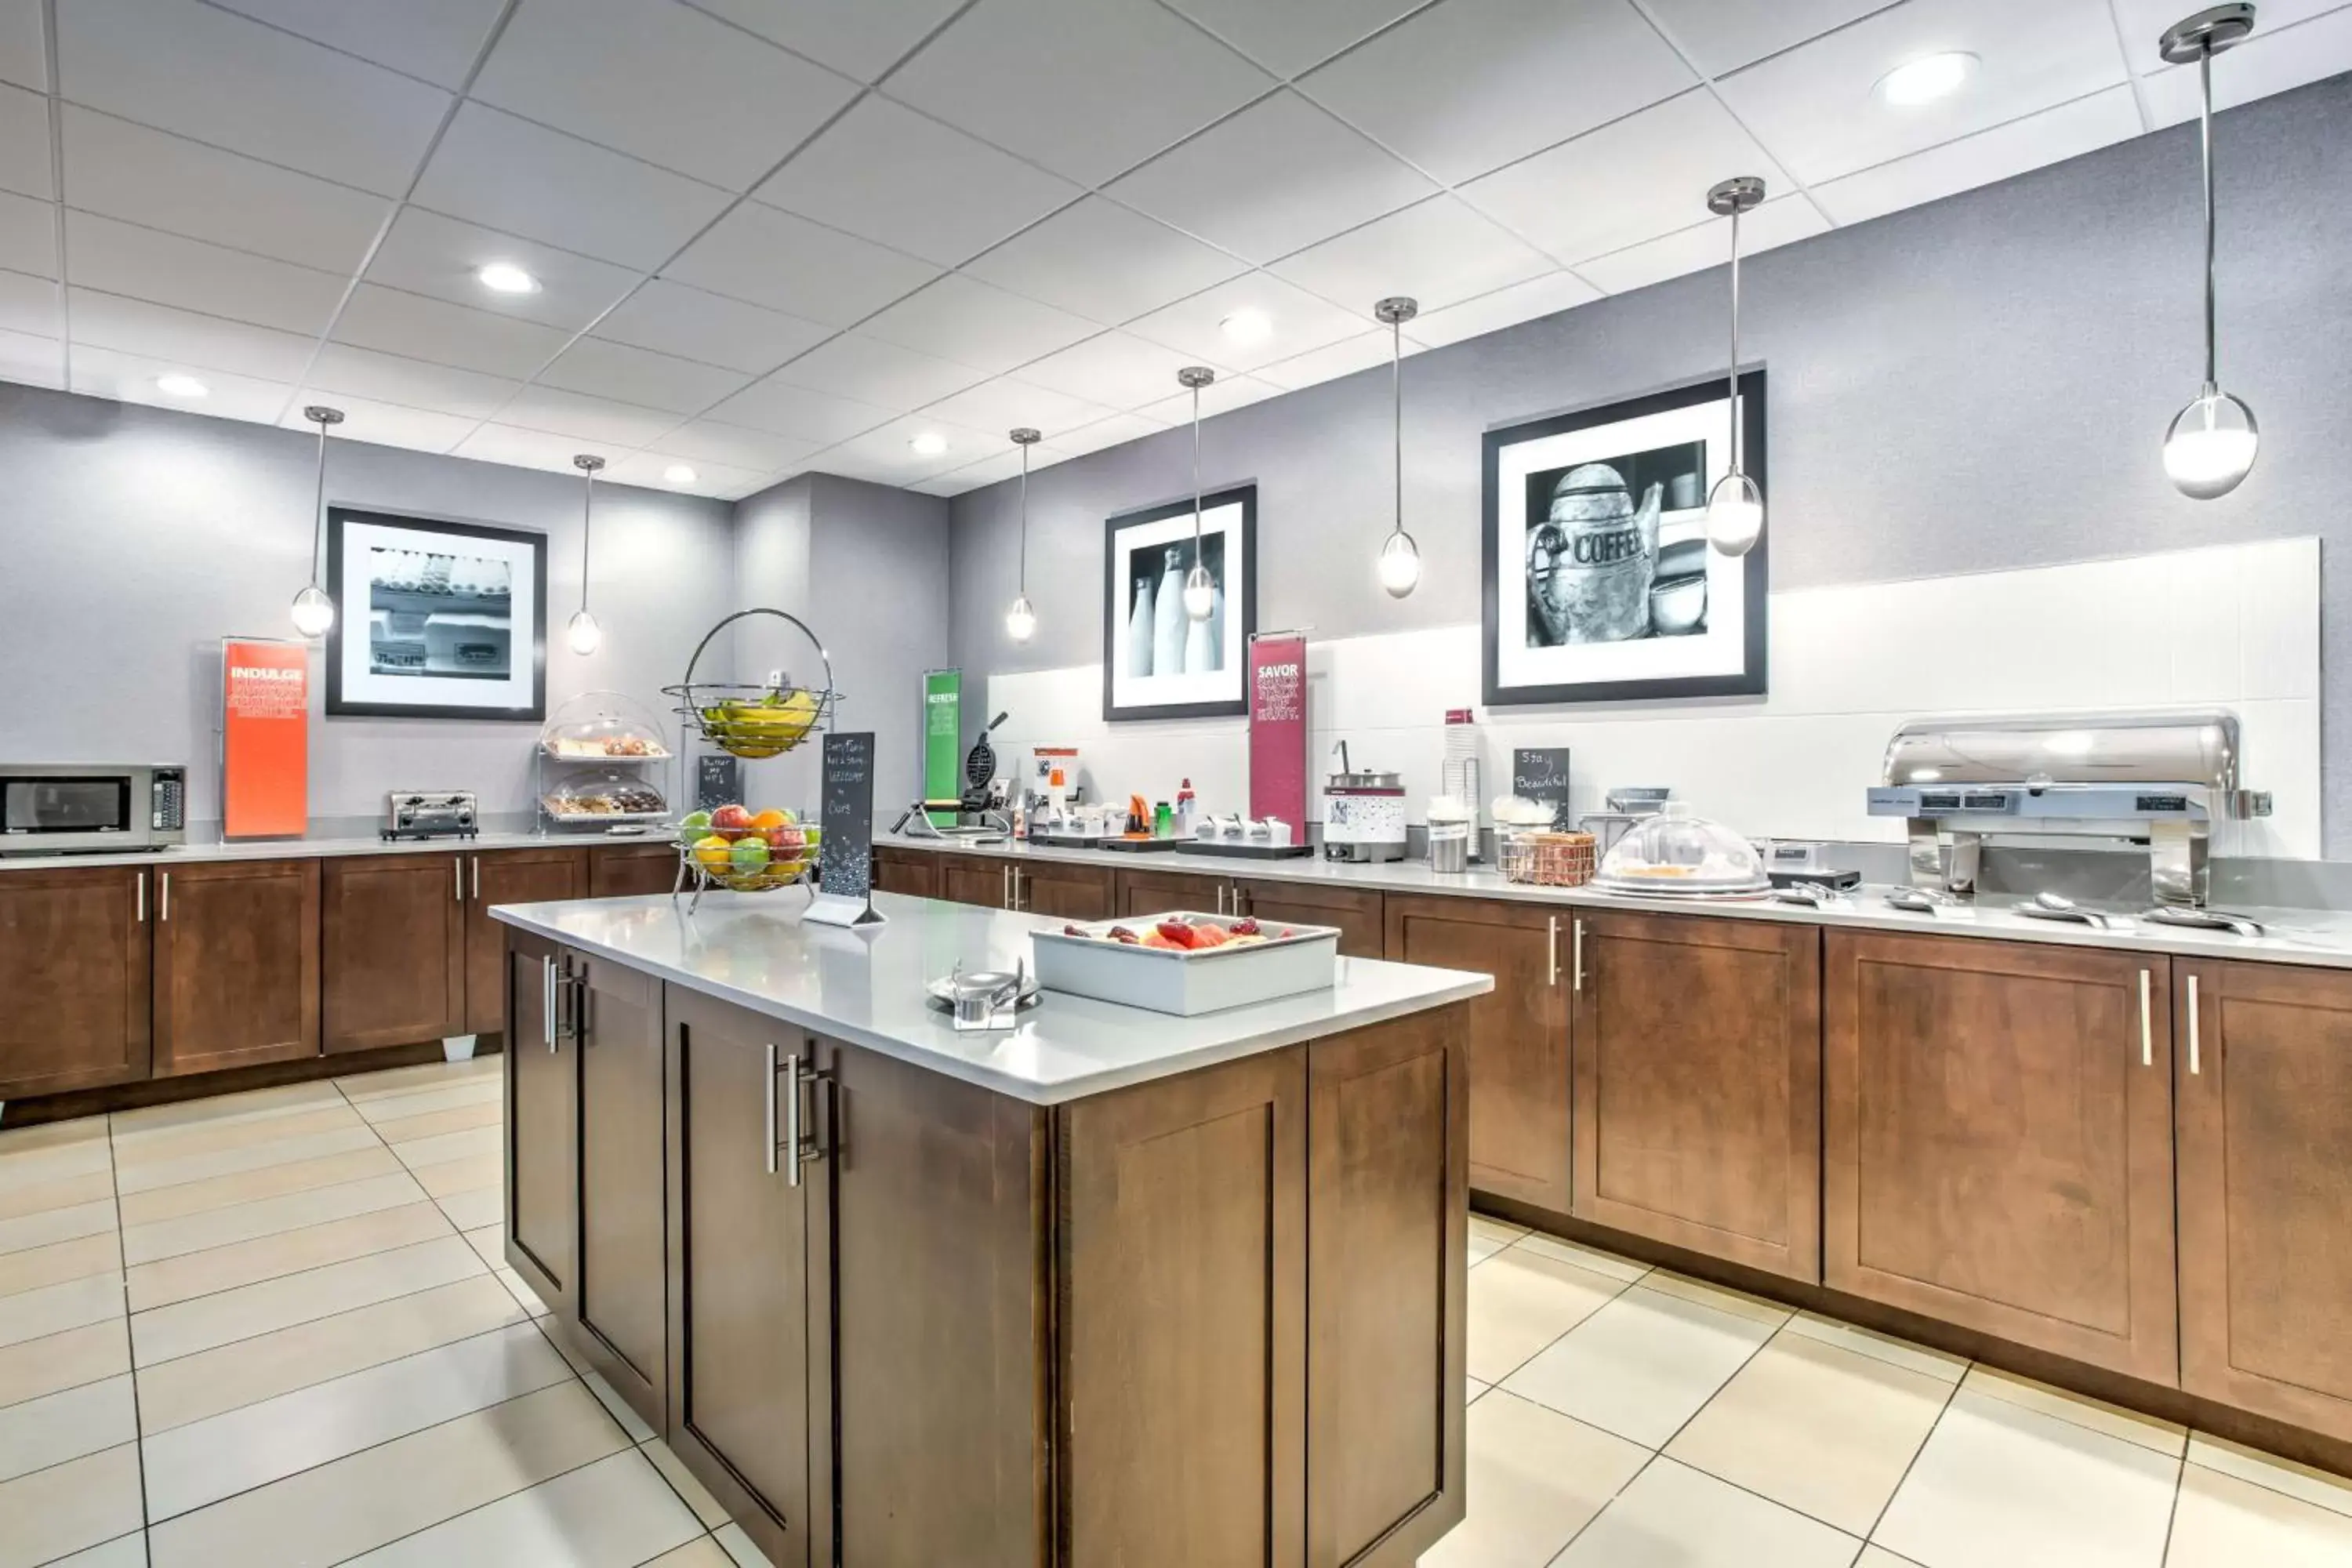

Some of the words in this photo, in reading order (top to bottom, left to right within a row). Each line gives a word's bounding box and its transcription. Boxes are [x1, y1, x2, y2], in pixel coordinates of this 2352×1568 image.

[1573, 527, 1642, 564] COFFEE
[231, 667, 303, 681] INDULGE
[1258, 664, 1298, 678] SAVOR
[927, 693, 959, 704] REFRESH
[1522, 752, 1553, 778] Stay
[1515, 773, 1567, 789] Beautiful
